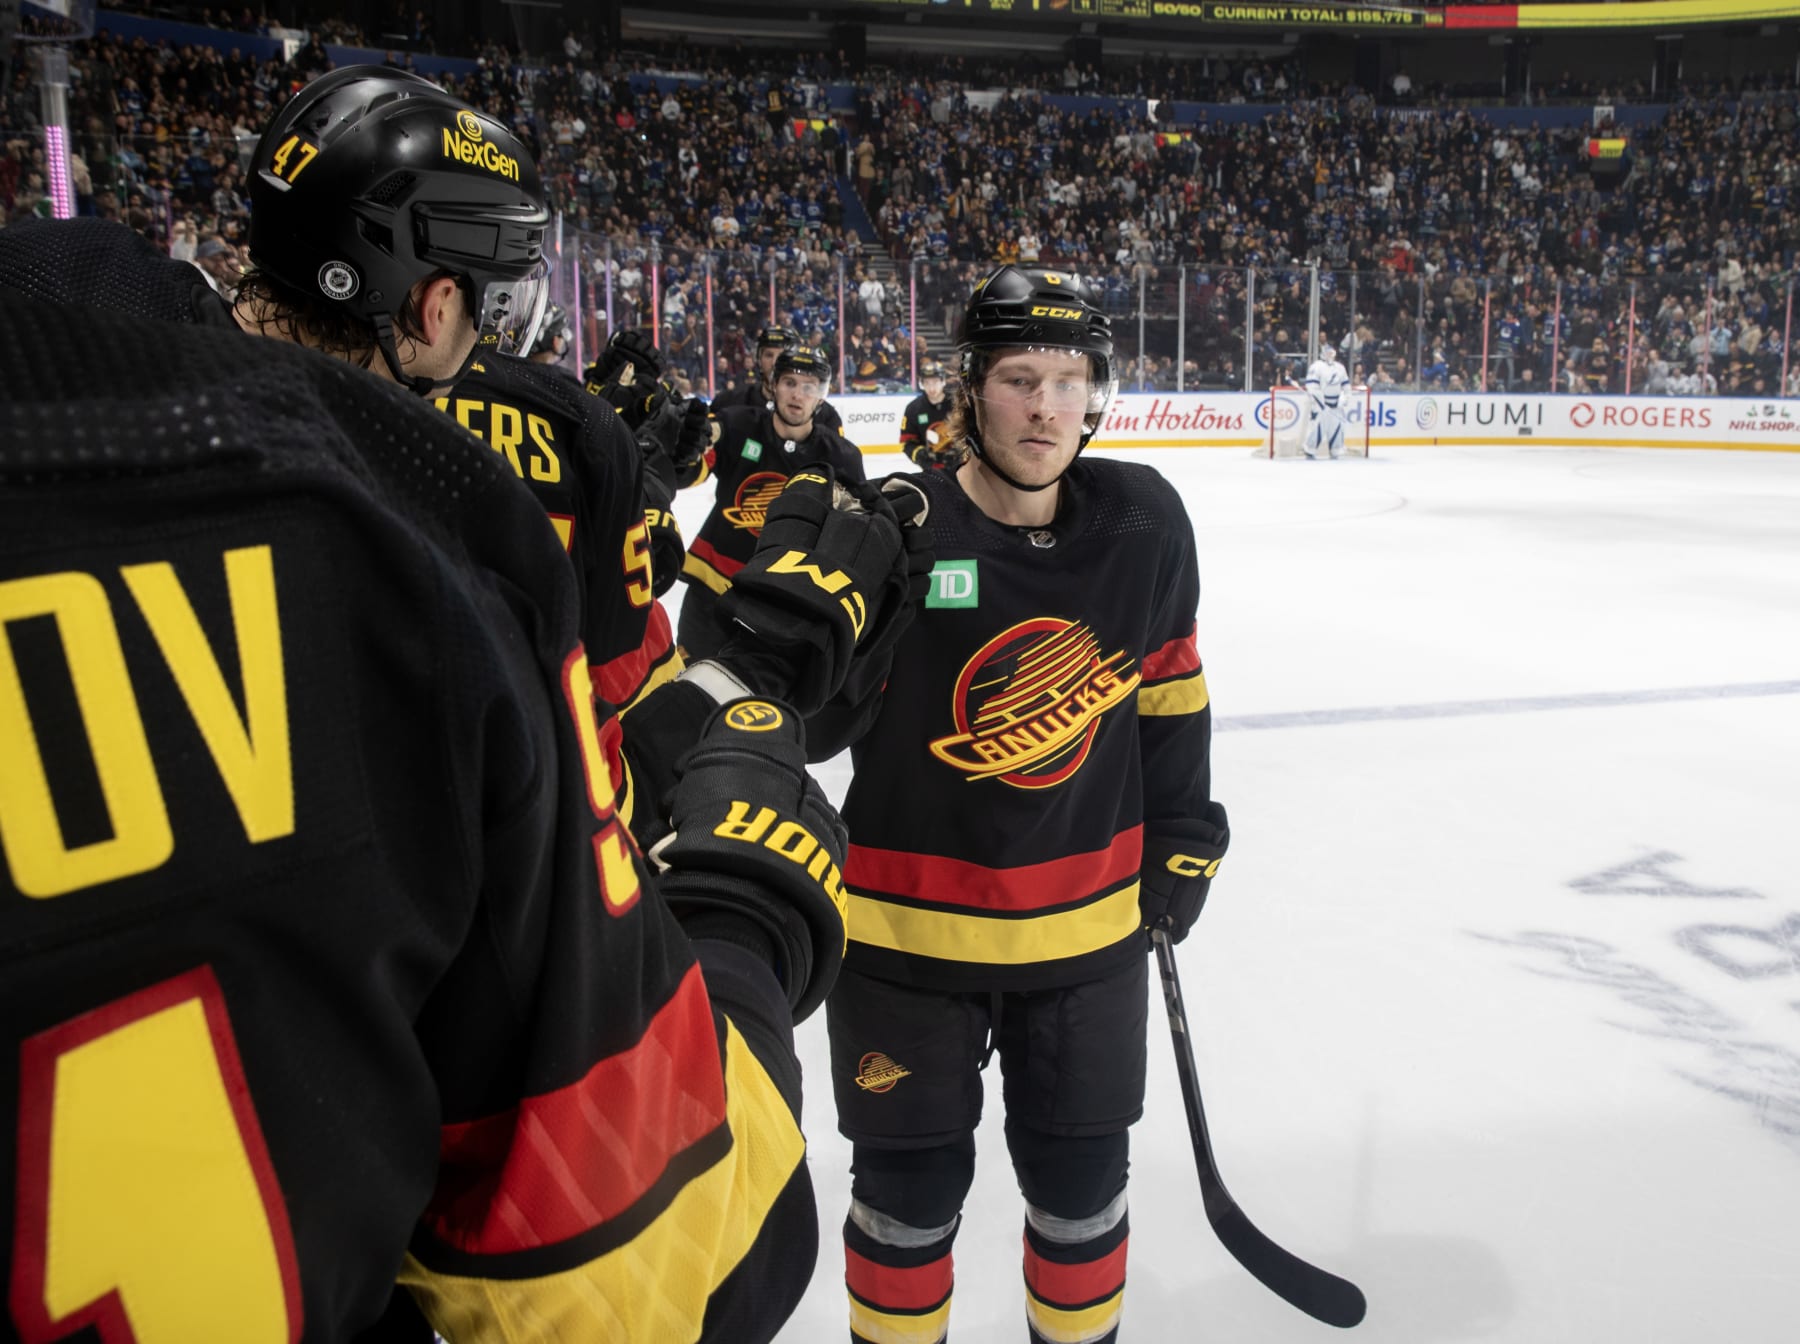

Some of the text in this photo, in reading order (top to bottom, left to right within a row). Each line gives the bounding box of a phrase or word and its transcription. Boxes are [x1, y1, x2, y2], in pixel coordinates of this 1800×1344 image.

[1213, 7, 1286, 20] CURRENT
[1292, 9, 1344, 22] TOTAL:
[273, 135, 319, 184] 47
[442, 127, 520, 182] NexGen
[1031, 306, 1083, 320] CCM
[848, 412, 896, 424] SPORTS
[1105, 399, 1244, 431] im Hortons
[1447, 402, 1542, 425] HUMI
[1603, 406, 1712, 428] ROGERS
[435, 397, 561, 483] ERS
[930, 569, 973, 600] TD
